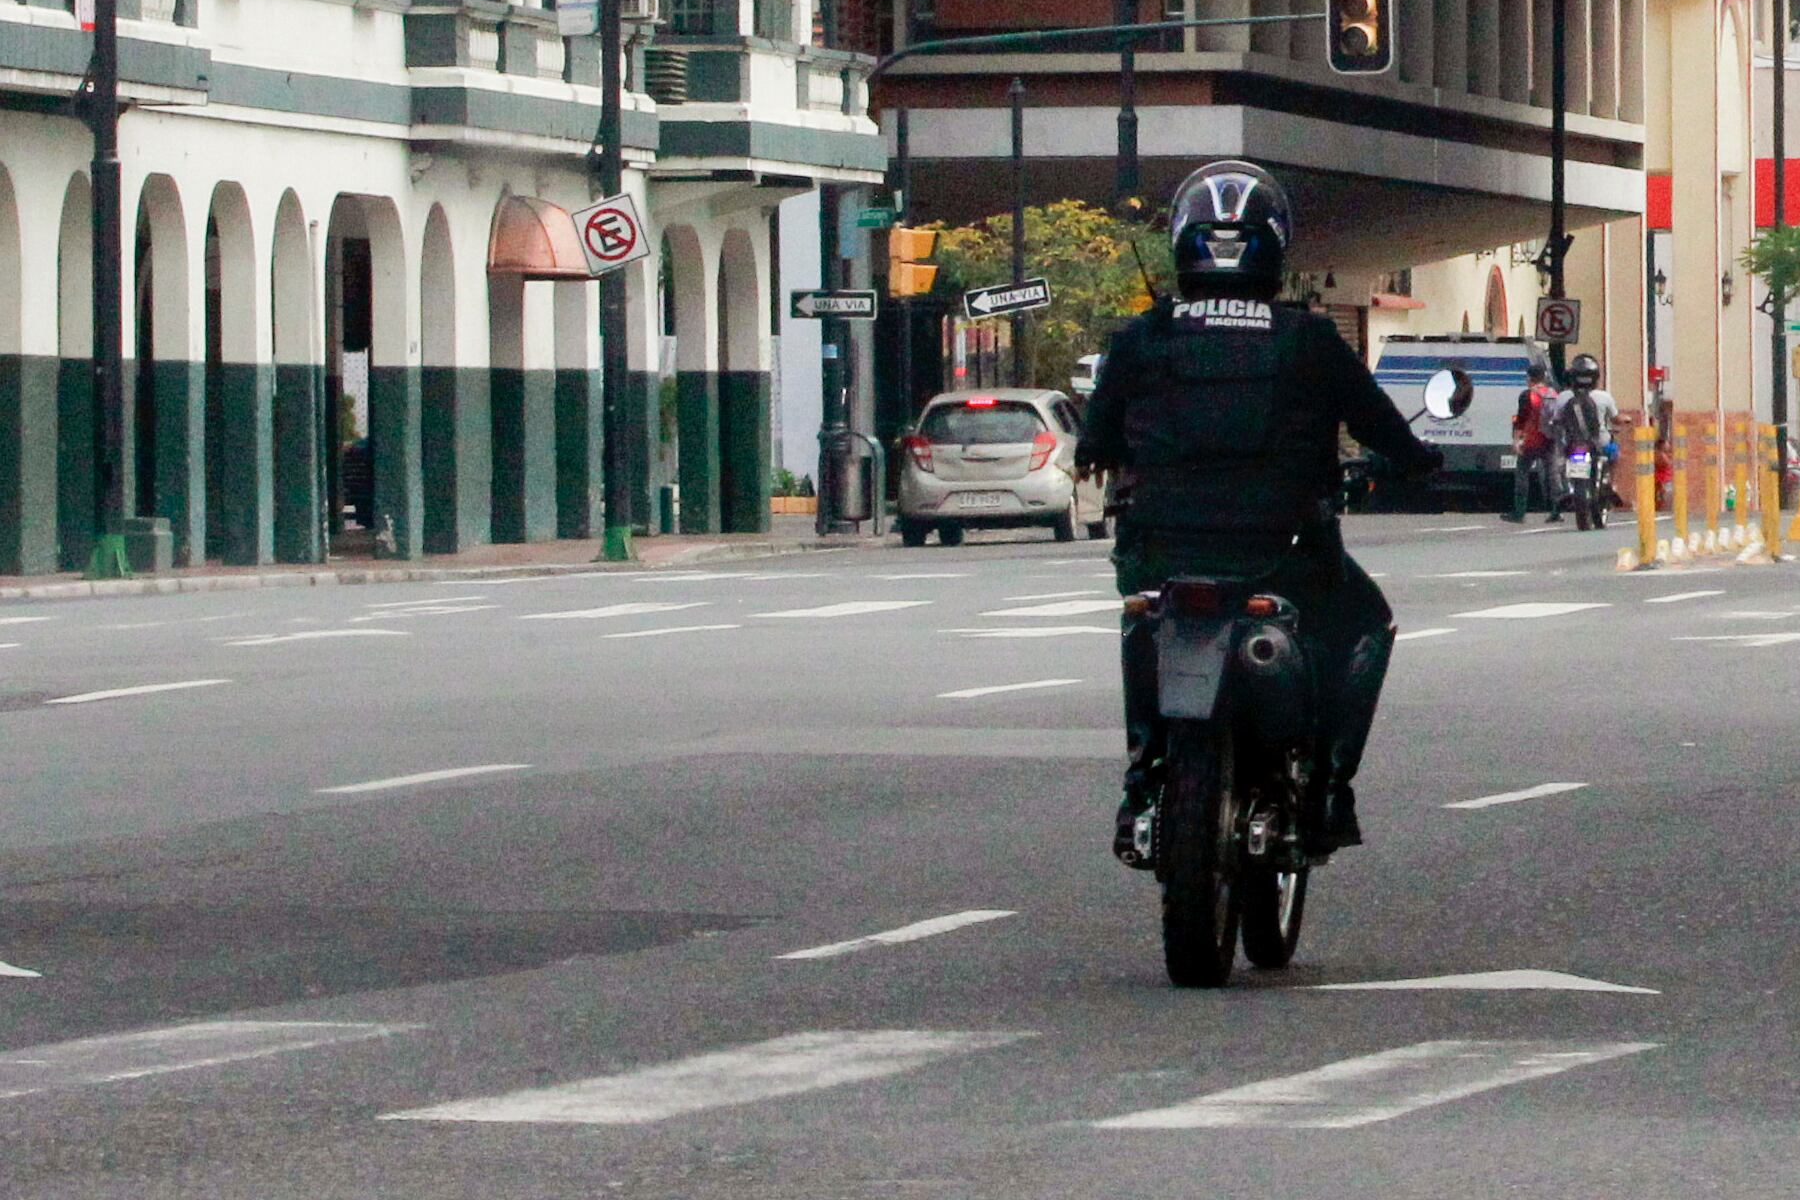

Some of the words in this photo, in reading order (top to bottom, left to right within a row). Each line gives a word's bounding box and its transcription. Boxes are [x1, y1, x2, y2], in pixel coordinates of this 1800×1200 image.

[990, 292, 1017, 305] UNA
[1019, 287, 1041, 299] VIA
[815, 300, 840, 310] UNA
[845, 300, 866, 310] VIA
[1205, 317, 1271, 329] NACIONAL
